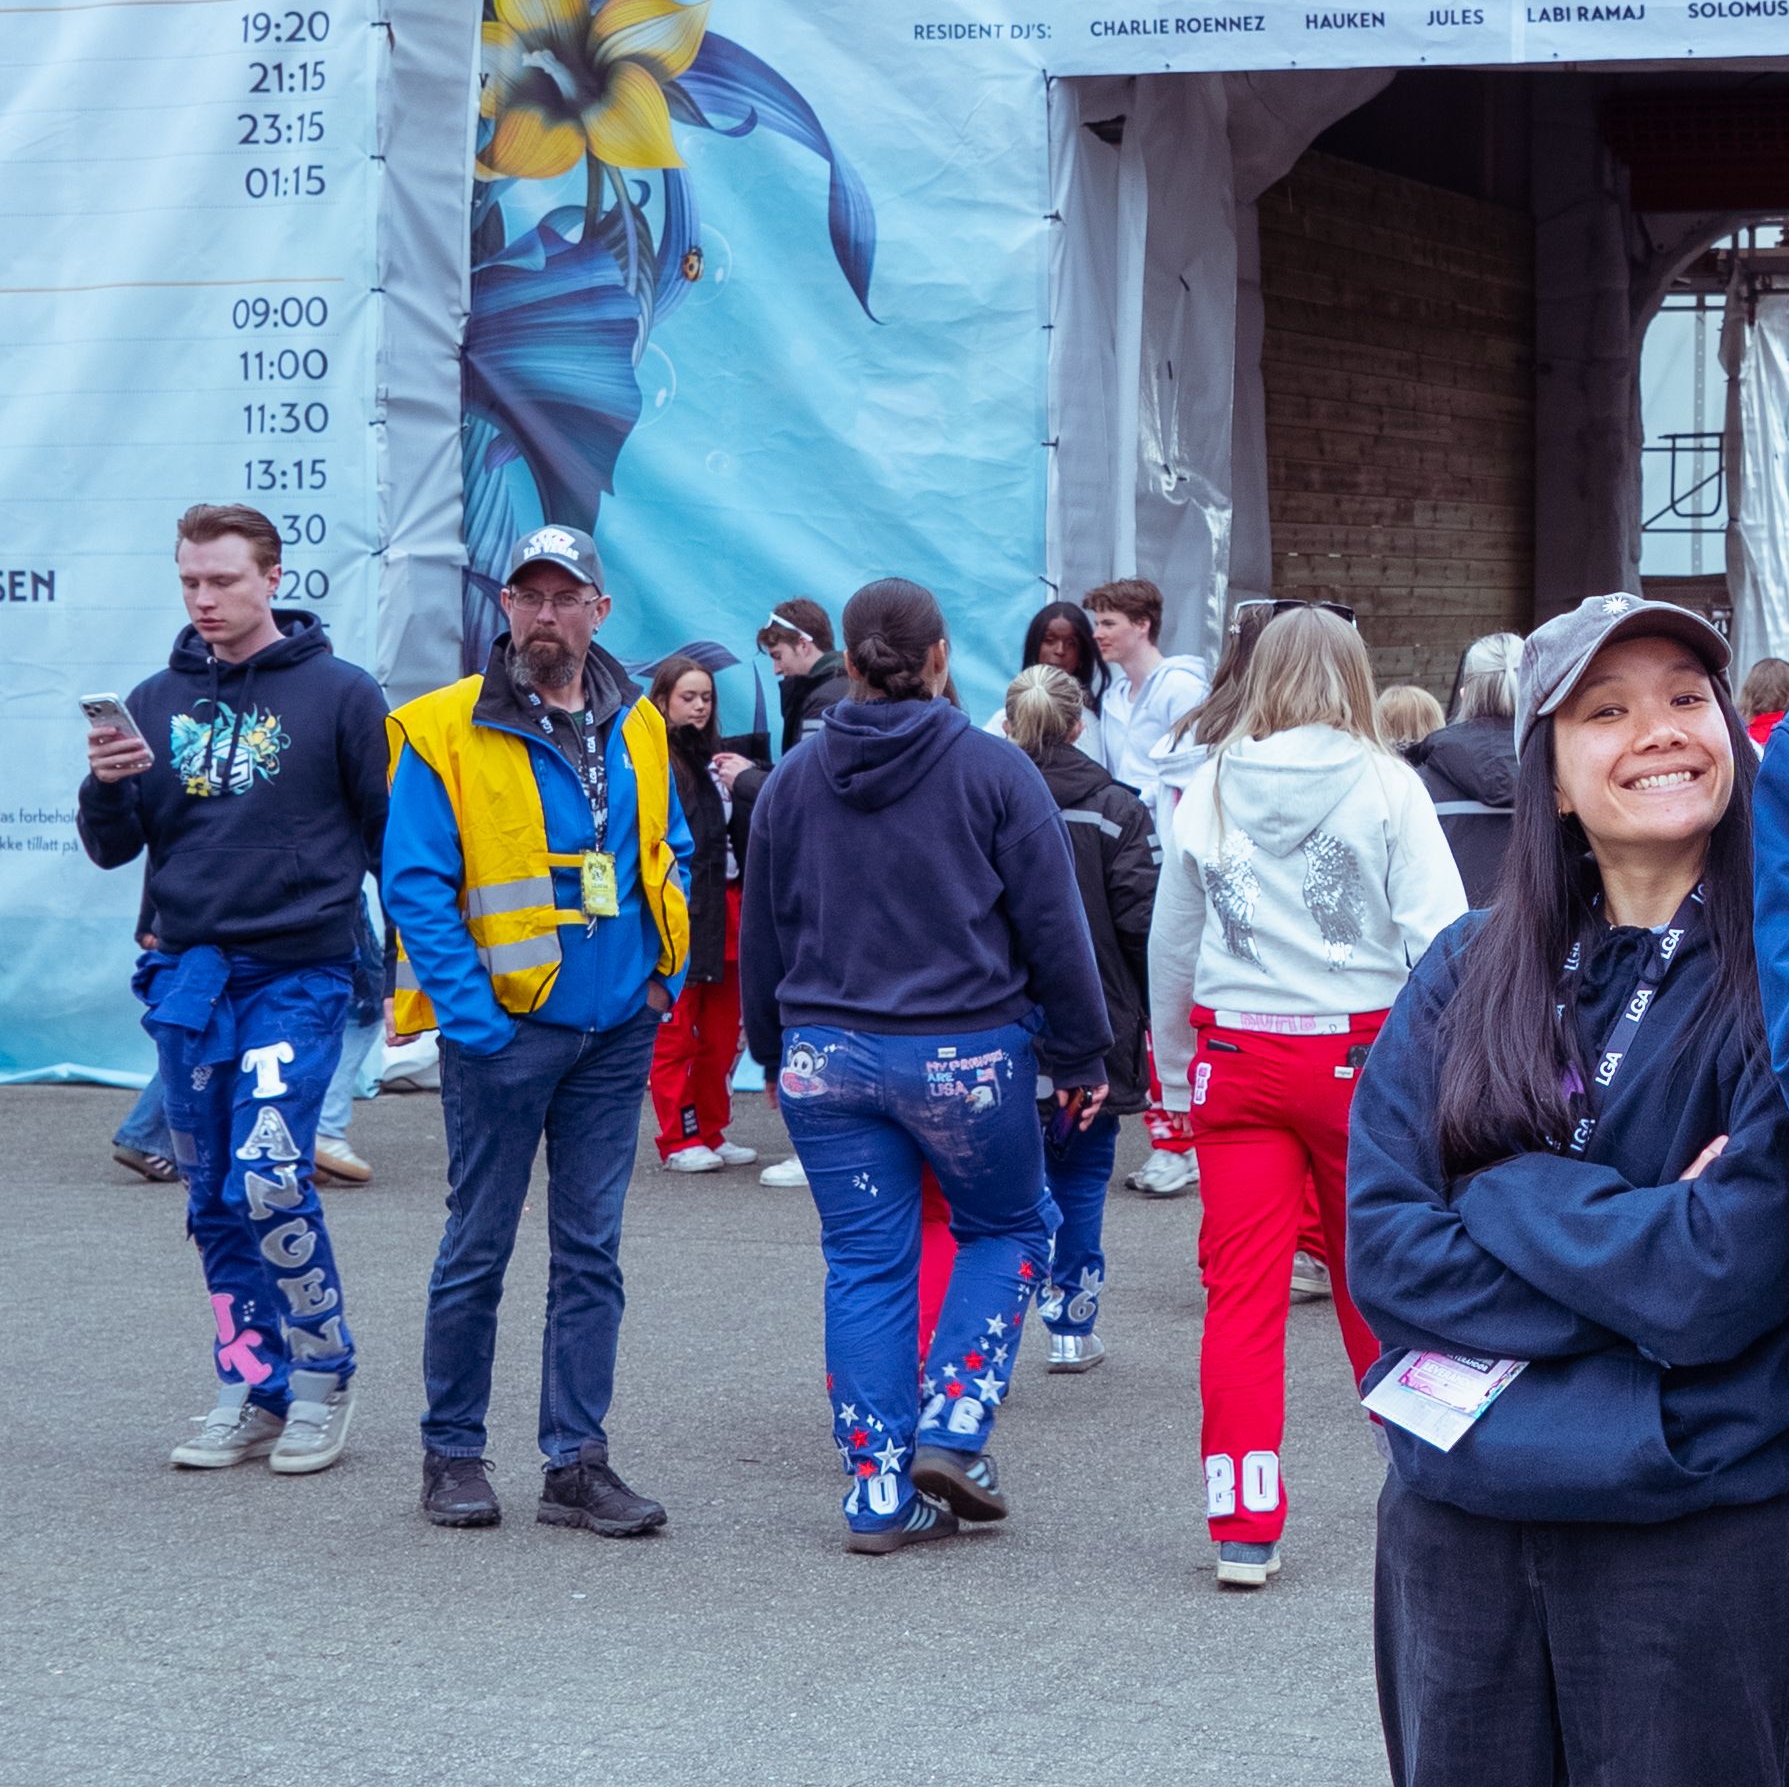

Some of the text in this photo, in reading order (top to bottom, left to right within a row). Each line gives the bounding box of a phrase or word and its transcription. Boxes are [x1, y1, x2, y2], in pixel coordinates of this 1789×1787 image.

[242, 10, 330, 44] 19:20
[914, 23, 1003, 41] RESIDENT
[1010, 22, 1052, 40] DJ'S:
[1090, 18, 1170, 37] CHARLIE
[1175, 15, 1266, 35] ROENNEZ
[1305, 11, 1386, 30] HAUKEN
[1426, 9, 1485, 27] JULES
[1526, 6, 1571, 24] LABI
[1577, 3, 1646, 22] RAMAJ
[248, 60, 327, 94] 21:15
[237, 111, 325, 145] 23:15
[245, 164, 326, 199] 01:15
[232, 295, 328, 330] 09:00
[239, 348, 328, 381] 11:00
[243, 401, 329, 435] 11:30
[245, 458, 328, 491] 13:15
[540, 715, 554, 735] LGA
[585, 710, 594, 726] LGA
[587, 735, 597, 754] LGA
[589, 766, 598, 785] LGA
[20, 808, 77, 824] forbehol
[1660, 927, 1685, 961] LGA
[1625, 988, 1653, 1024] LGA
[1594, 1050, 1624, 1087] LGA
[930, 1079, 969, 1098] USA
[1570, 1117, 1596, 1153] LGA
[1038, 1283, 1097, 1323] 26
[1204, 1450, 1280, 1520] 20
